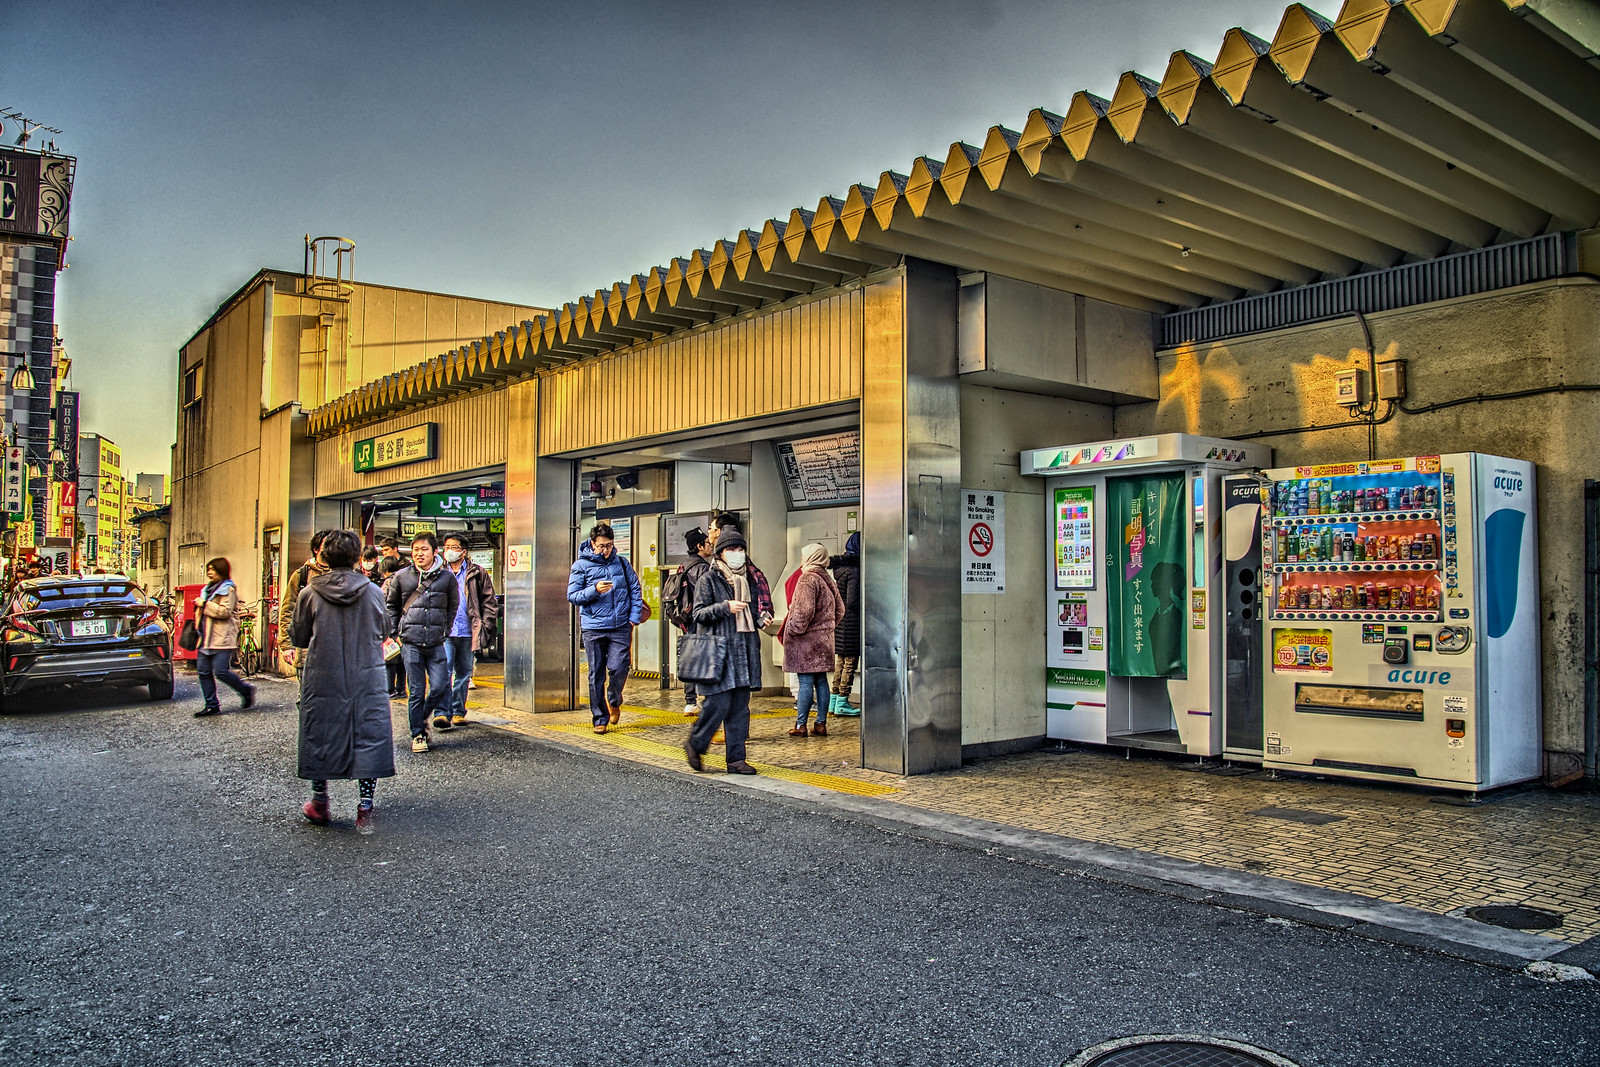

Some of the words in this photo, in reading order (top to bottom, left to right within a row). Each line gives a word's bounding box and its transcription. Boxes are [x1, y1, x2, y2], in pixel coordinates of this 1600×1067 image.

[406, 436, 426, 448] Uguisudani
[358, 444, 370, 462] JR
[406, 448, 418, 456] Station
[1060, 443, 1136, 463] 証明写真
[1212, 447, 1246, 460] 証明写真
[1494, 476, 1523, 492] acure
[1232, 488, 1260, 496] acure
[440, 496, 462, 509] JR
[975, 506, 994, 514] Smoking
[1147, 492, 1157, 544] キレイな
[1130, 498, 1143, 569] 証明写真
[1132, 578, 1144, 654] すぐ出来ます
[1388, 670, 1451, 685] acure
